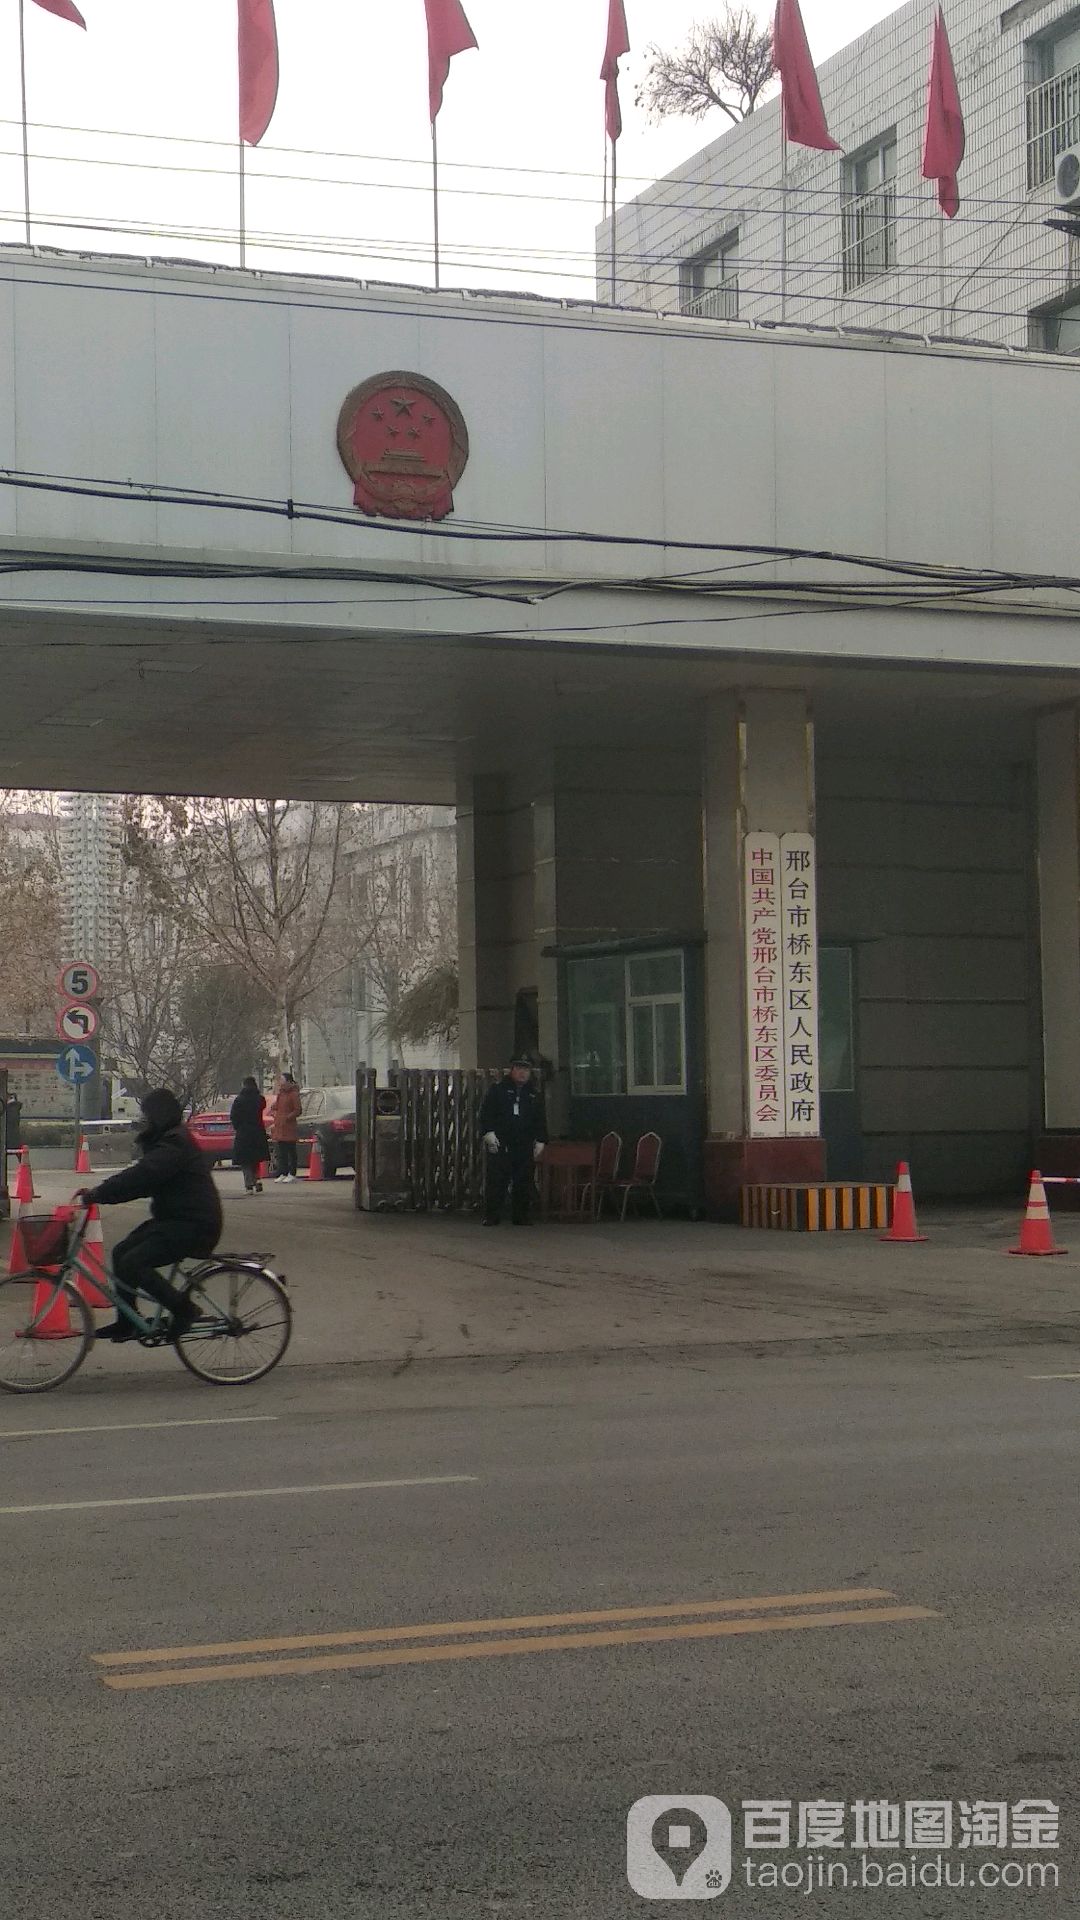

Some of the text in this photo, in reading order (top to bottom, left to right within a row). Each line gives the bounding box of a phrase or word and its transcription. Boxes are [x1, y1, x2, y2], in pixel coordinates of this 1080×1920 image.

[71, 970, 89, 995] 5
[750, 847, 780, 1122] 中国共产党邢台市桥东区委员会
[784, 849, 815, 1122] 邢台市桥东区人民政府
